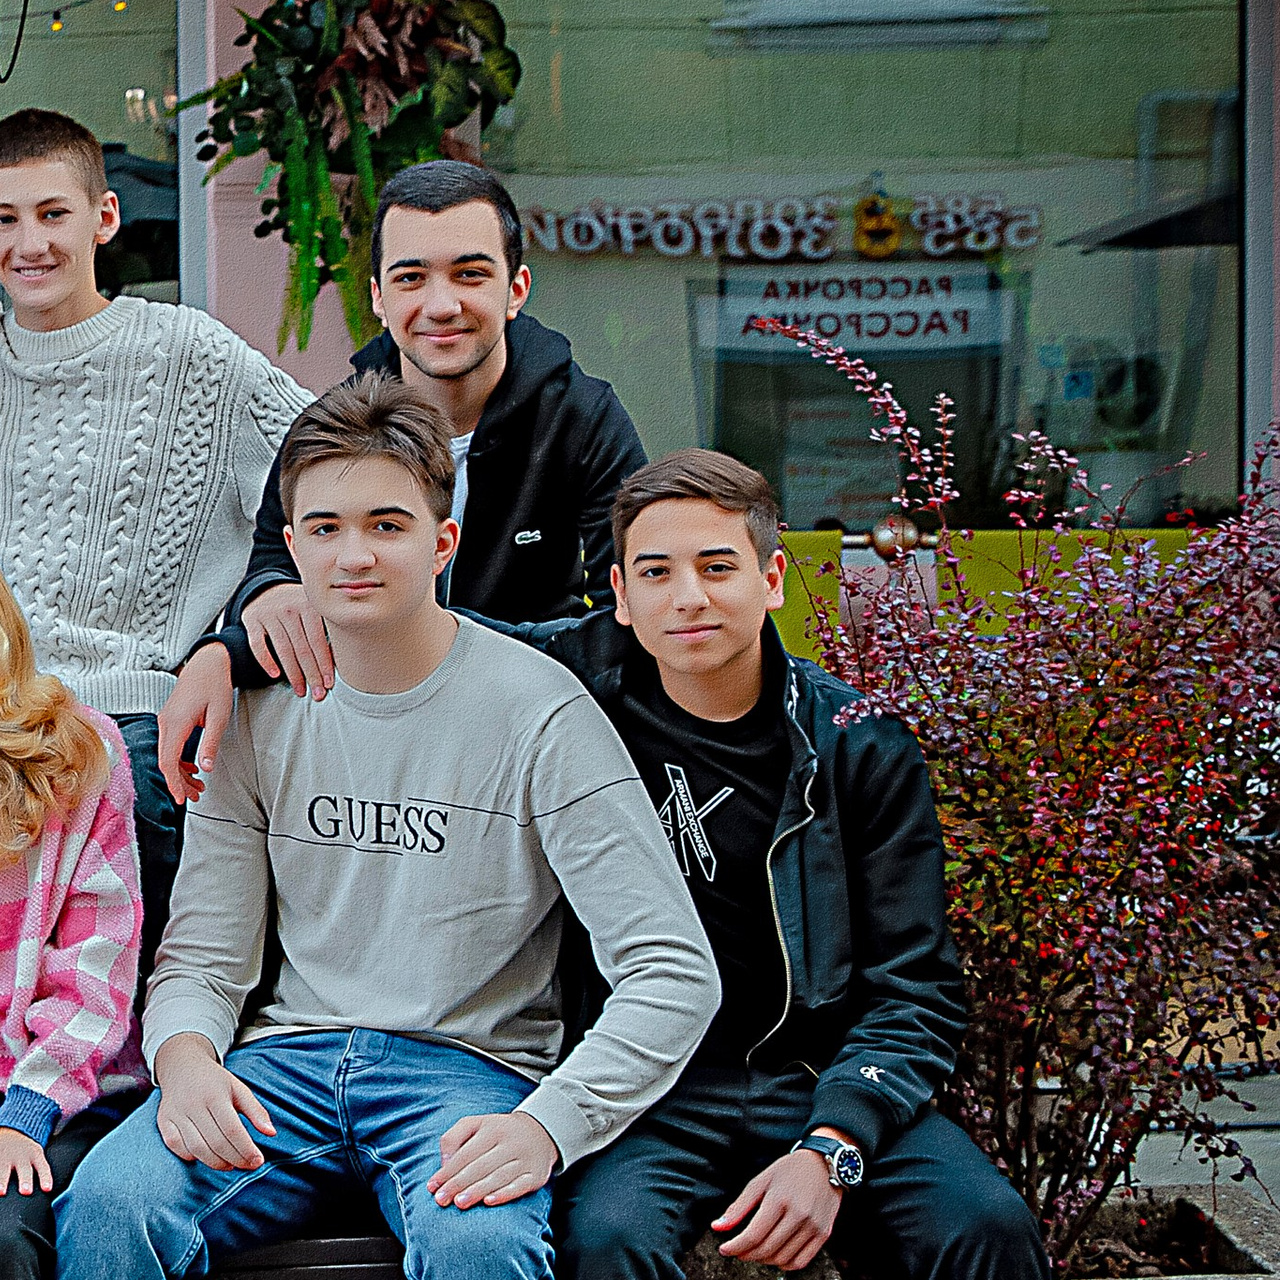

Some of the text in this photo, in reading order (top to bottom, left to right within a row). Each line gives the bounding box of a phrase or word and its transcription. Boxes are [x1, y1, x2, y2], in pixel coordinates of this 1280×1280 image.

[307, 795, 449, 854] GUESS
[674, 779, 709, 858] ARMANI EXCHANGE
